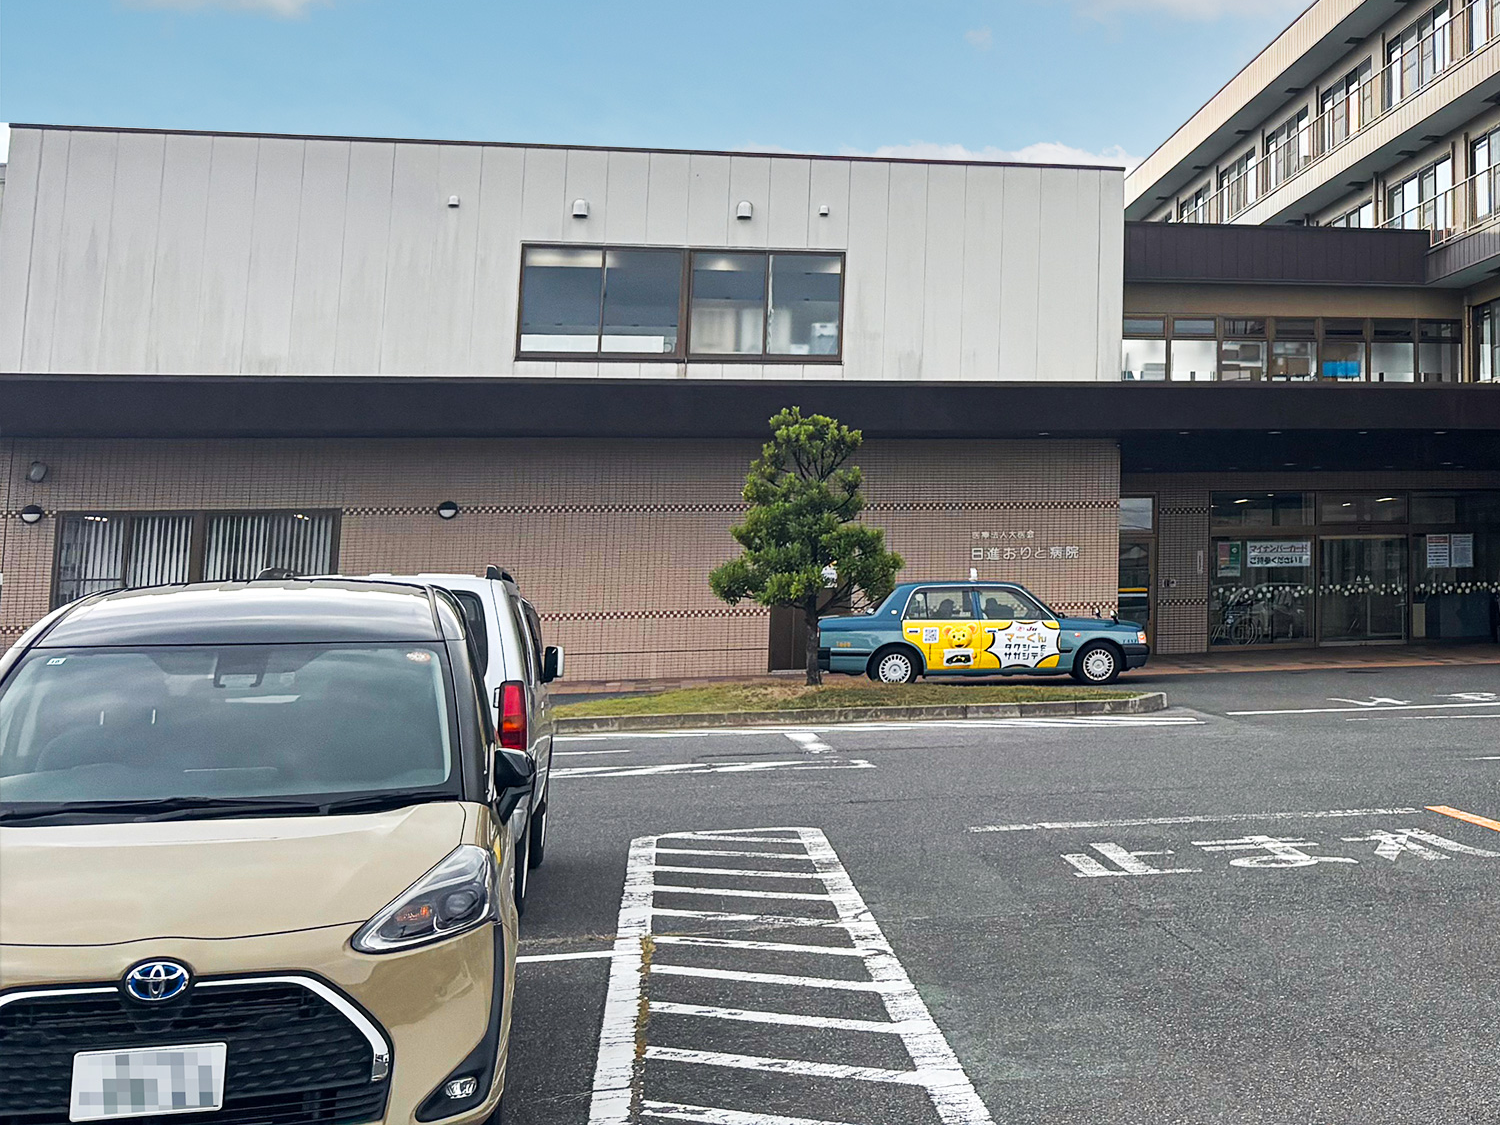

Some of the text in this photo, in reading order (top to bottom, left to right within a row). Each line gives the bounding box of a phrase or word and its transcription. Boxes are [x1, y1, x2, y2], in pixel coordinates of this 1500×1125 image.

[1005, 632, 1047, 643] マーくん
[1004, 643, 1047, 653] タクシーを
